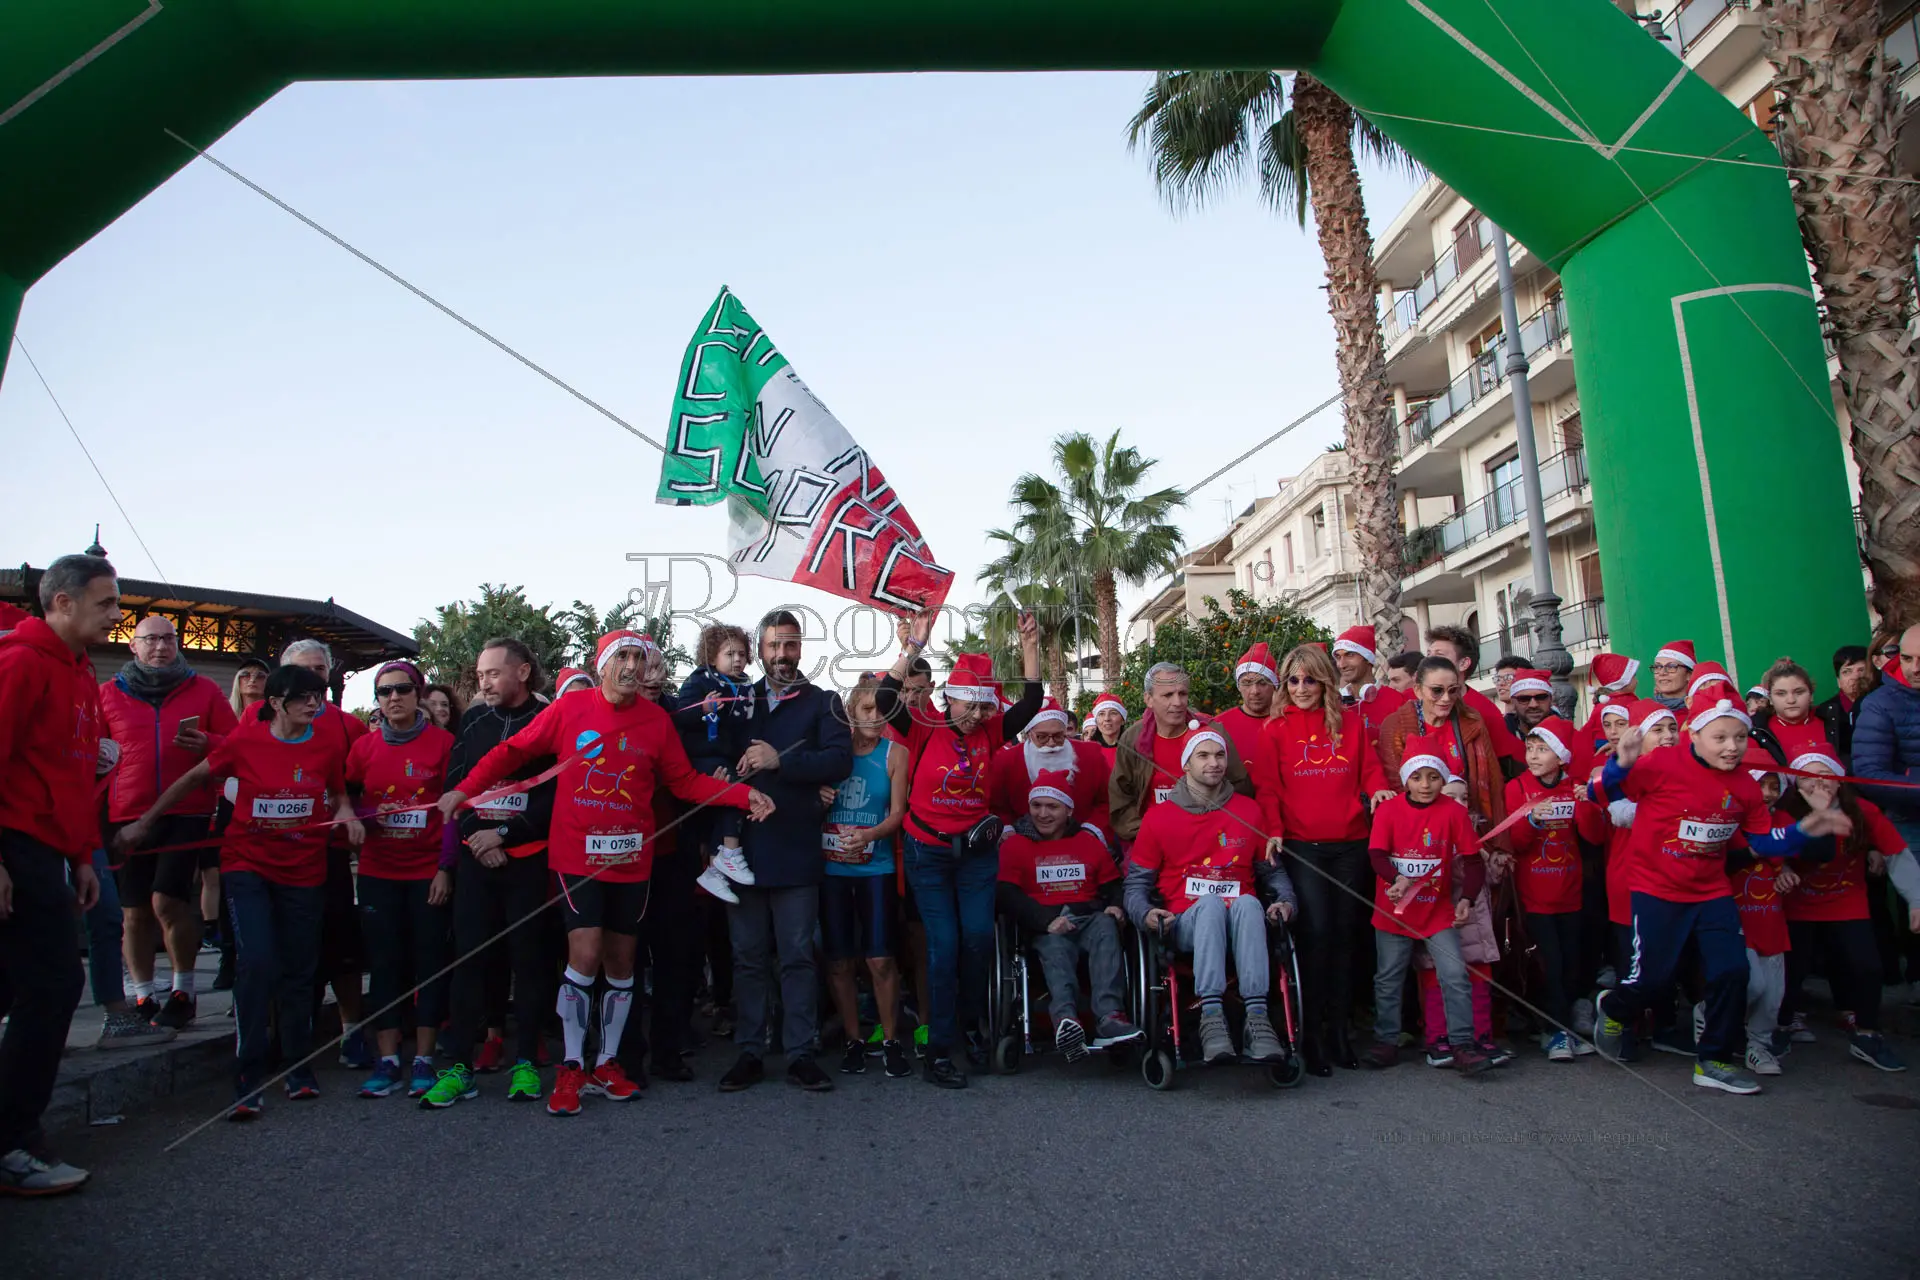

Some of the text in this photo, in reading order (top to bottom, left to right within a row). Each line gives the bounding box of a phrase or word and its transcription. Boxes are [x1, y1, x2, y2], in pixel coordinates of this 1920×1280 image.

[1294, 767, 1328, 779] HAPPY
[278, 803, 307, 814] 0266
[573, 796, 633, 812] HAPPY RUN
[1554, 804, 1573, 816] 172
[393, 813, 419, 824] 0371
[610, 838, 637, 850] 0796
[1056, 868, 1080, 878] 0725
[1208, 884, 1234, 894] 0667
